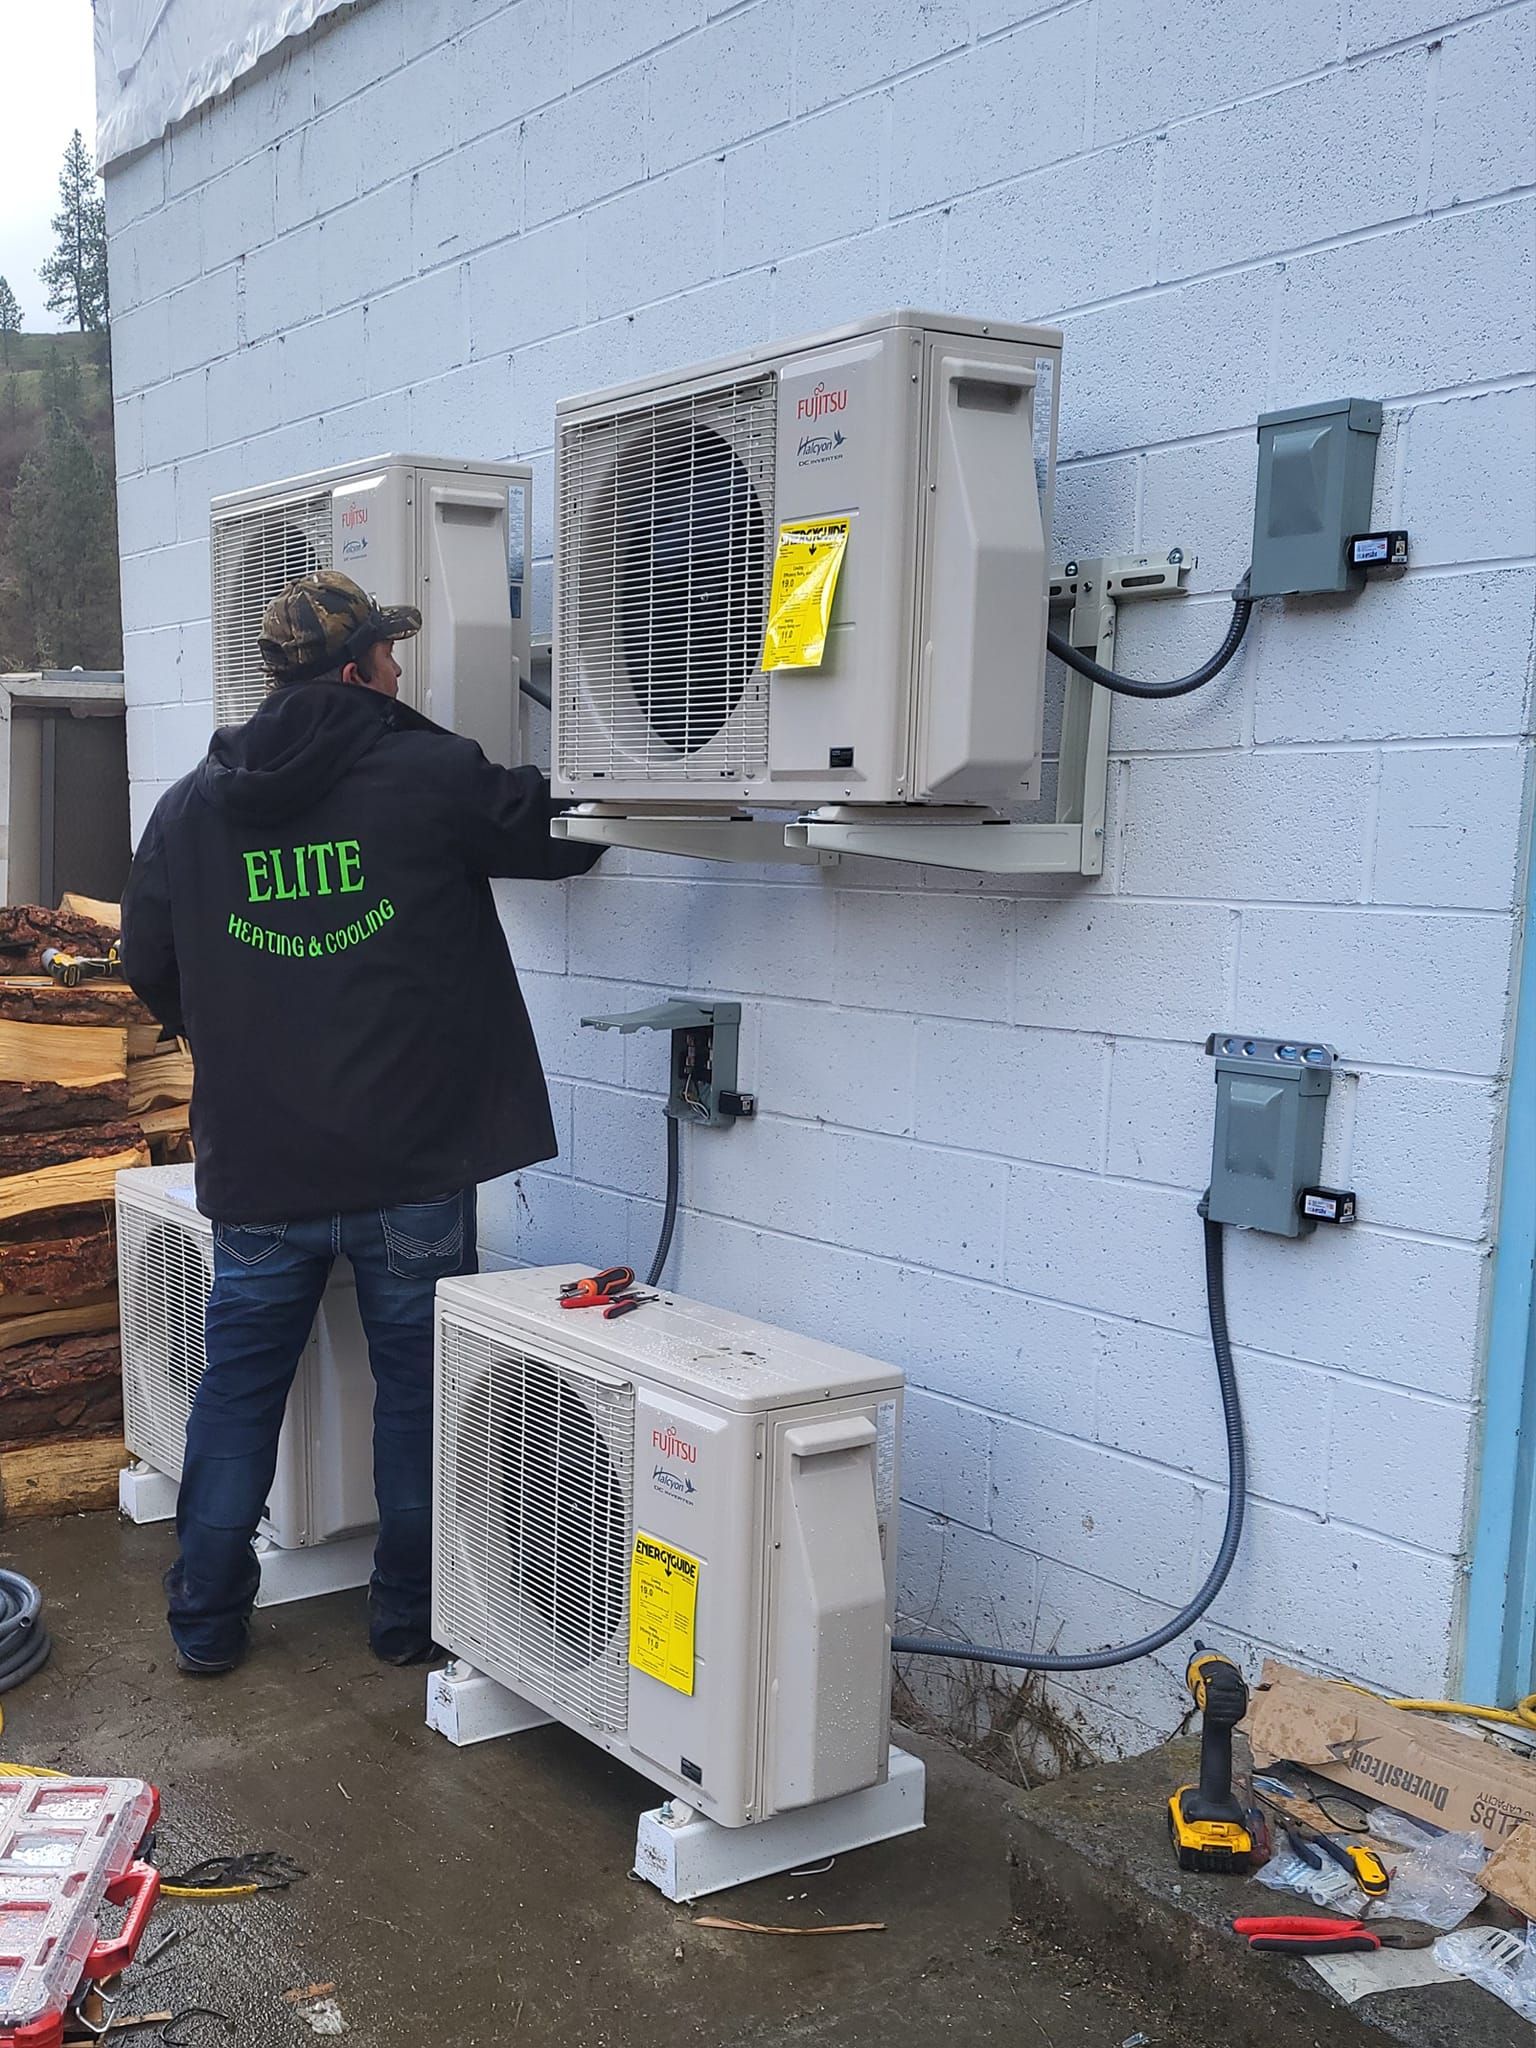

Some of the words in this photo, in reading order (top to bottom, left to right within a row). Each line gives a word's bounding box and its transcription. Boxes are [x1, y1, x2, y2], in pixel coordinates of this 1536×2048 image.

[797, 387, 848, 422] FUJITSU
[797, 435, 833, 456] Halcyon
[341, 506, 368, 530] FUJITSU
[242, 839, 366, 903] ELITE
[227, 912, 305, 958] HEATING
[308, 935, 323, 957] &
[325, 898, 396, 954] COOLING
[652, 1428, 697, 1464] FUJITSU
[652, 1464, 684, 1492] Halcyon
[636, 1540, 696, 1579] ENERGYGUIDE
